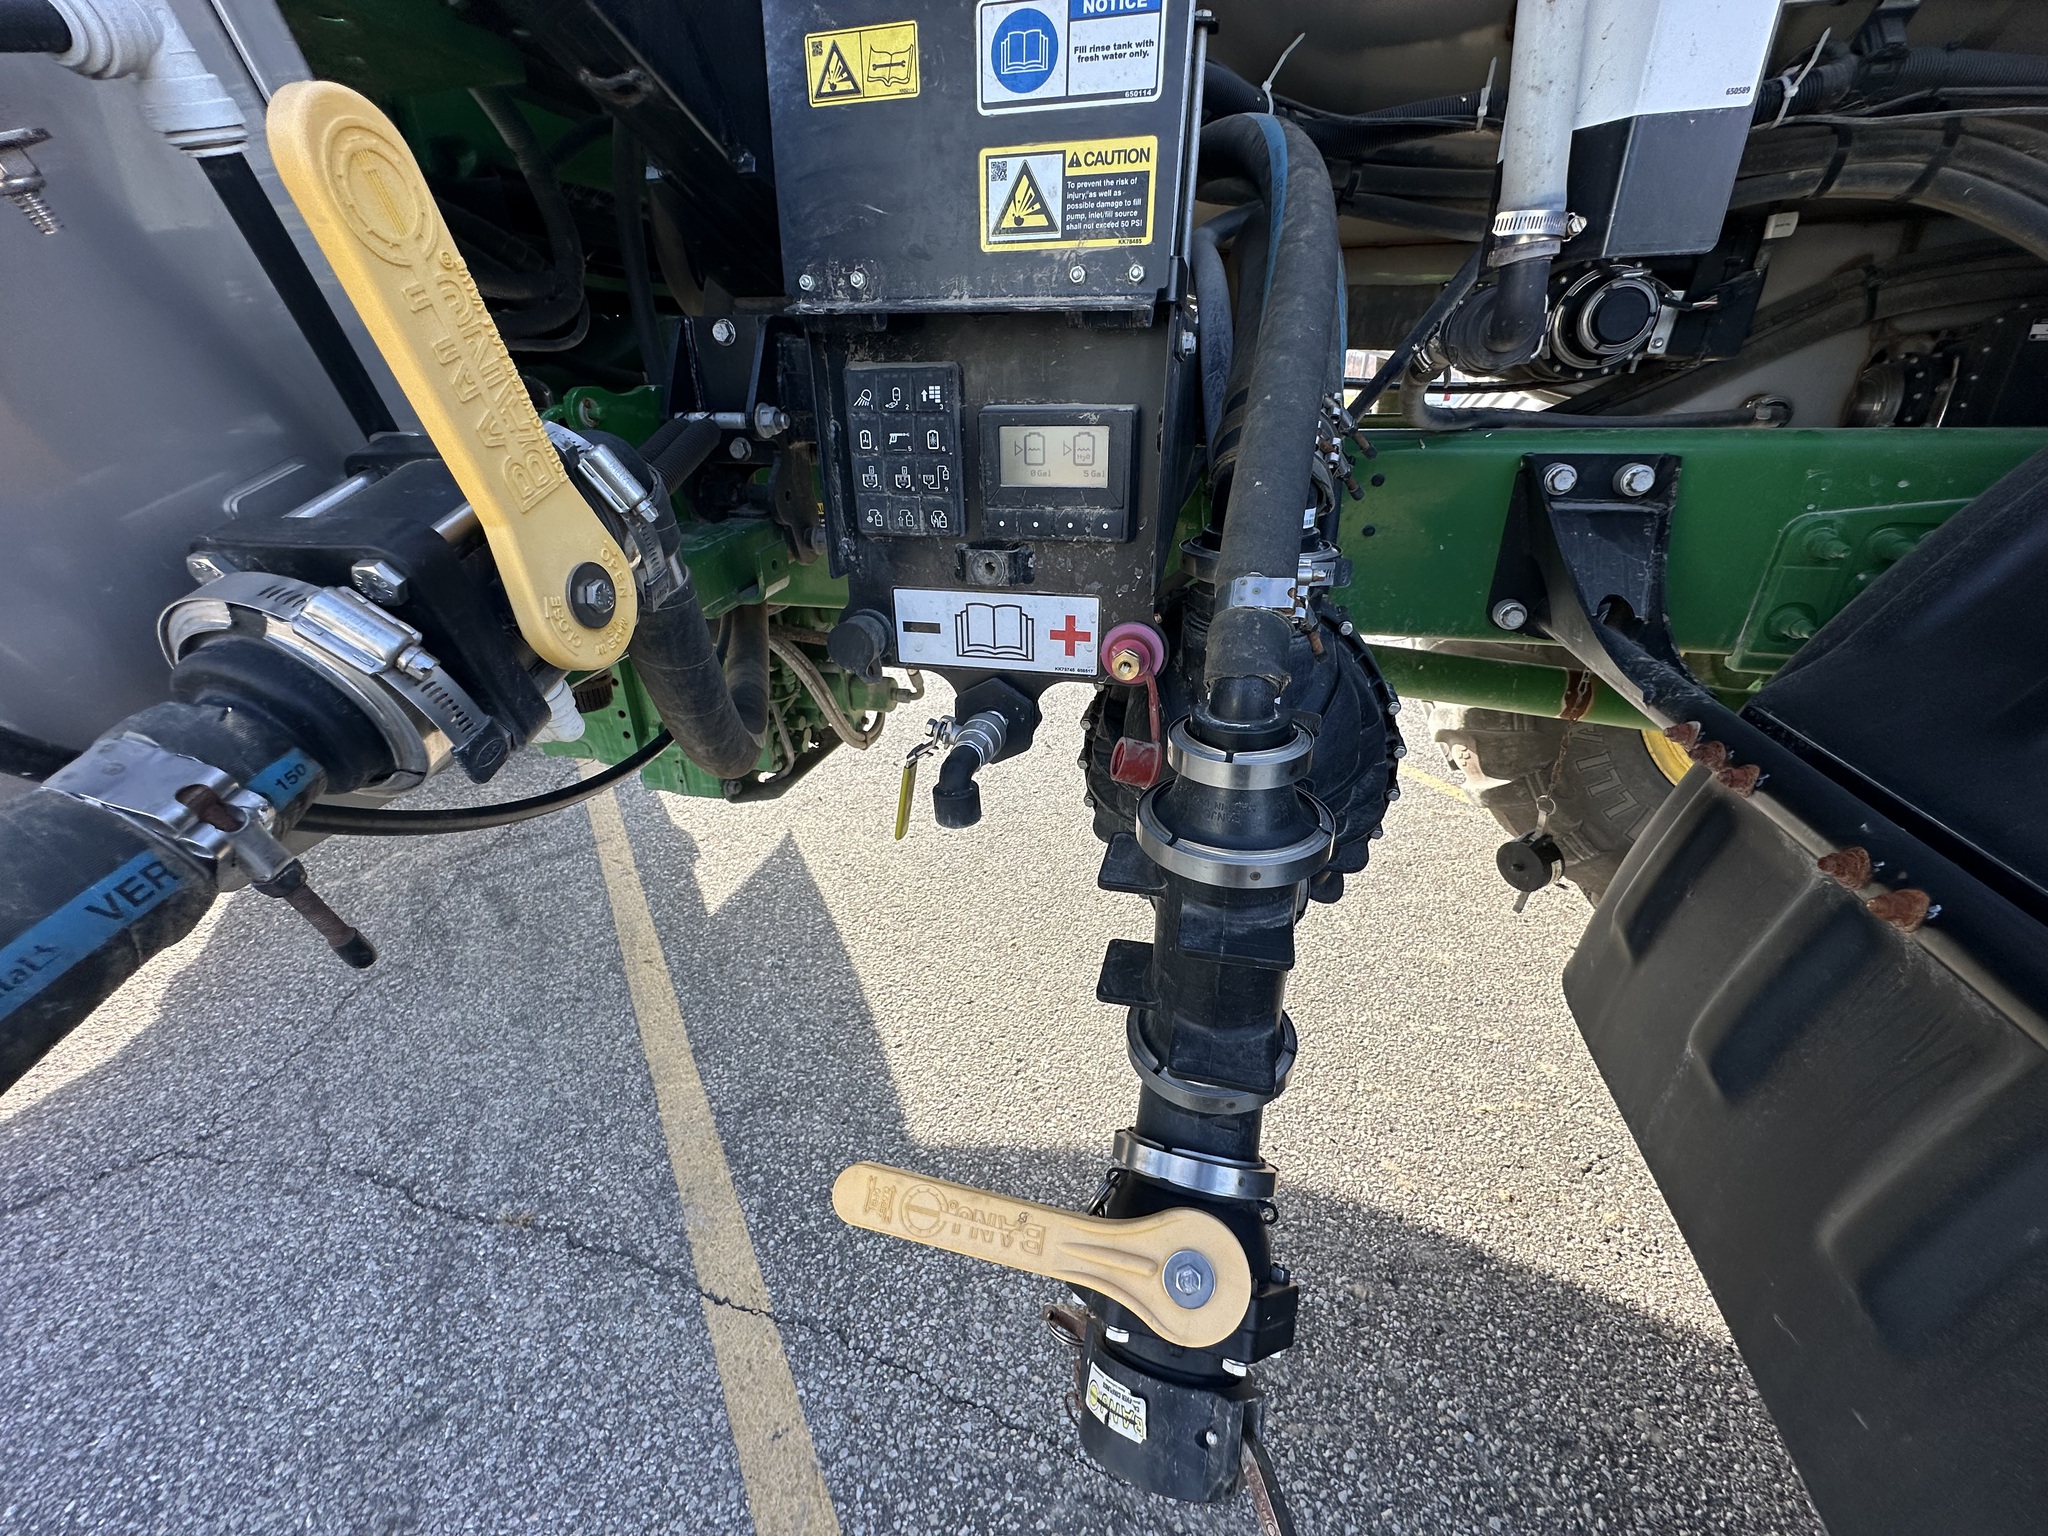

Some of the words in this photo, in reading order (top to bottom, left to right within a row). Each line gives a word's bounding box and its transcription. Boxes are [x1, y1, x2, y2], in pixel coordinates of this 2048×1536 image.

[1083, 0, 1148, 14] NOTICE
[1074, 45, 1086, 54] Fill
[1089, 44, 1111, 53] rinse
[1113, 41, 1132, 50] tank
[1135, 39, 1154, 48] with
[1077, 54, 1100, 62] fresh
[1102, 52, 1127, 60] water
[1129, 49, 1150, 58] only.
[1124, 89, 1152, 98] 650114
[1726, 86, 1750, 96] 650589
[1084, 148, 1150, 166] CAUTION
[1076, 180, 1102, 190] prevent
[1067, 192, 1087, 200] injury,
[1067, 201, 1094, 211] possible
[1096, 200, 1123, 209] damage
[600, 548, 628, 598] OPEN
[550, 596, 582, 648] CLOSE
[274, 762, 306, 792] 150
